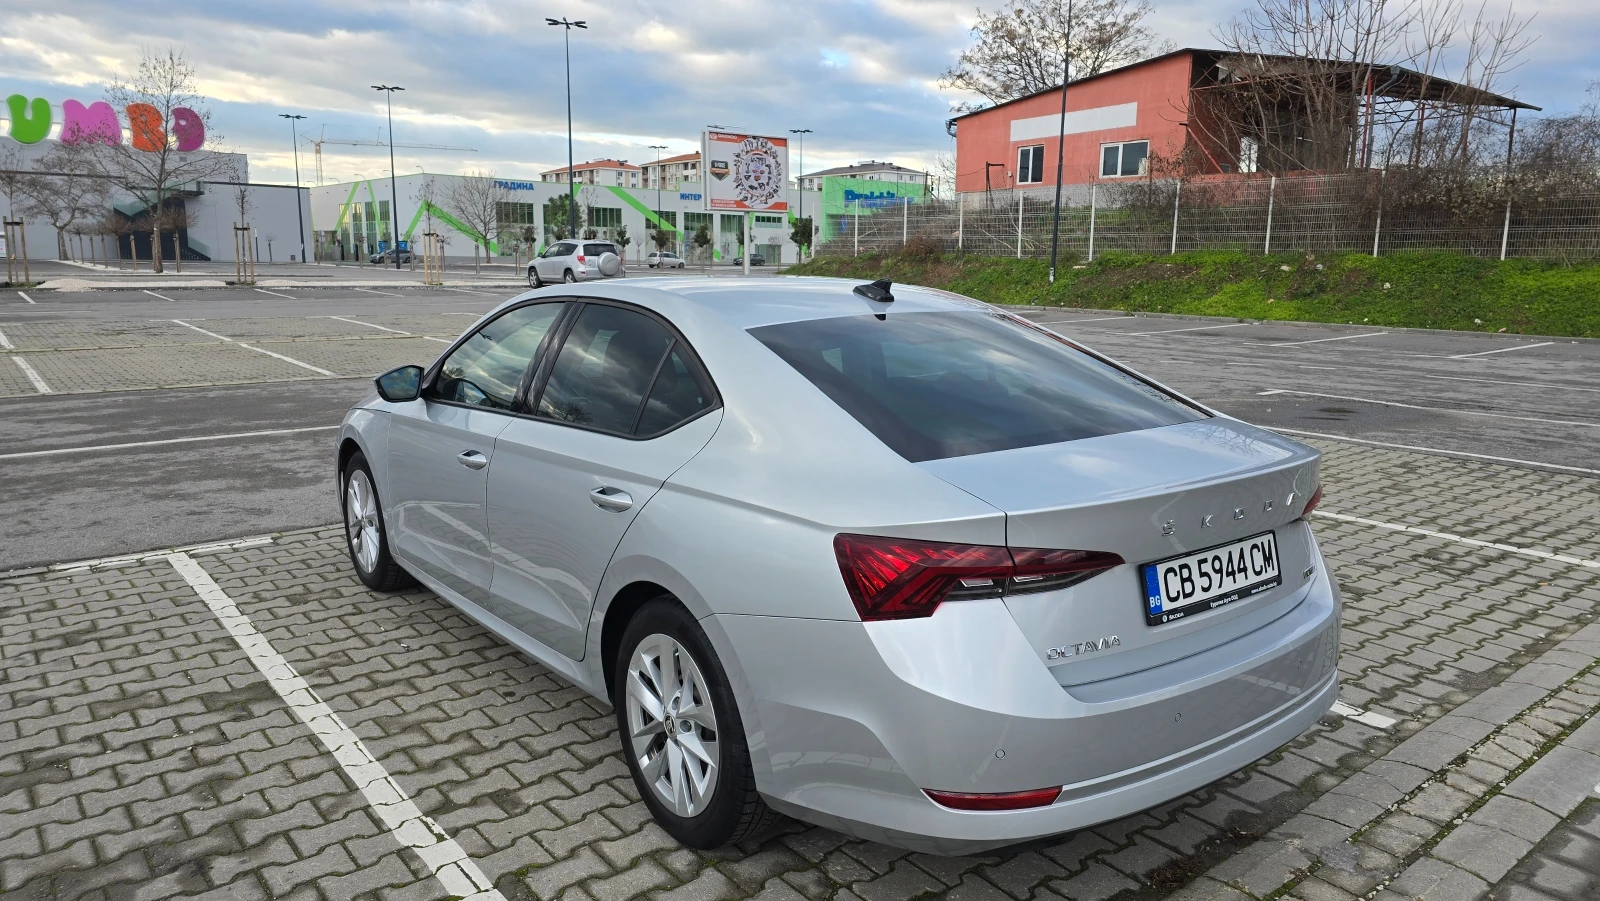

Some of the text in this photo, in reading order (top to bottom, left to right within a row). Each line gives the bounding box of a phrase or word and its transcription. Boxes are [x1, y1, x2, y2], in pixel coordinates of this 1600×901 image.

[493, 180, 534, 191] ГРАДИНА
[680, 192, 702, 201] ИНТЕР
[1149, 596, 1161, 608] BG
[1046, 634, 1121, 660] OCTAVIA
